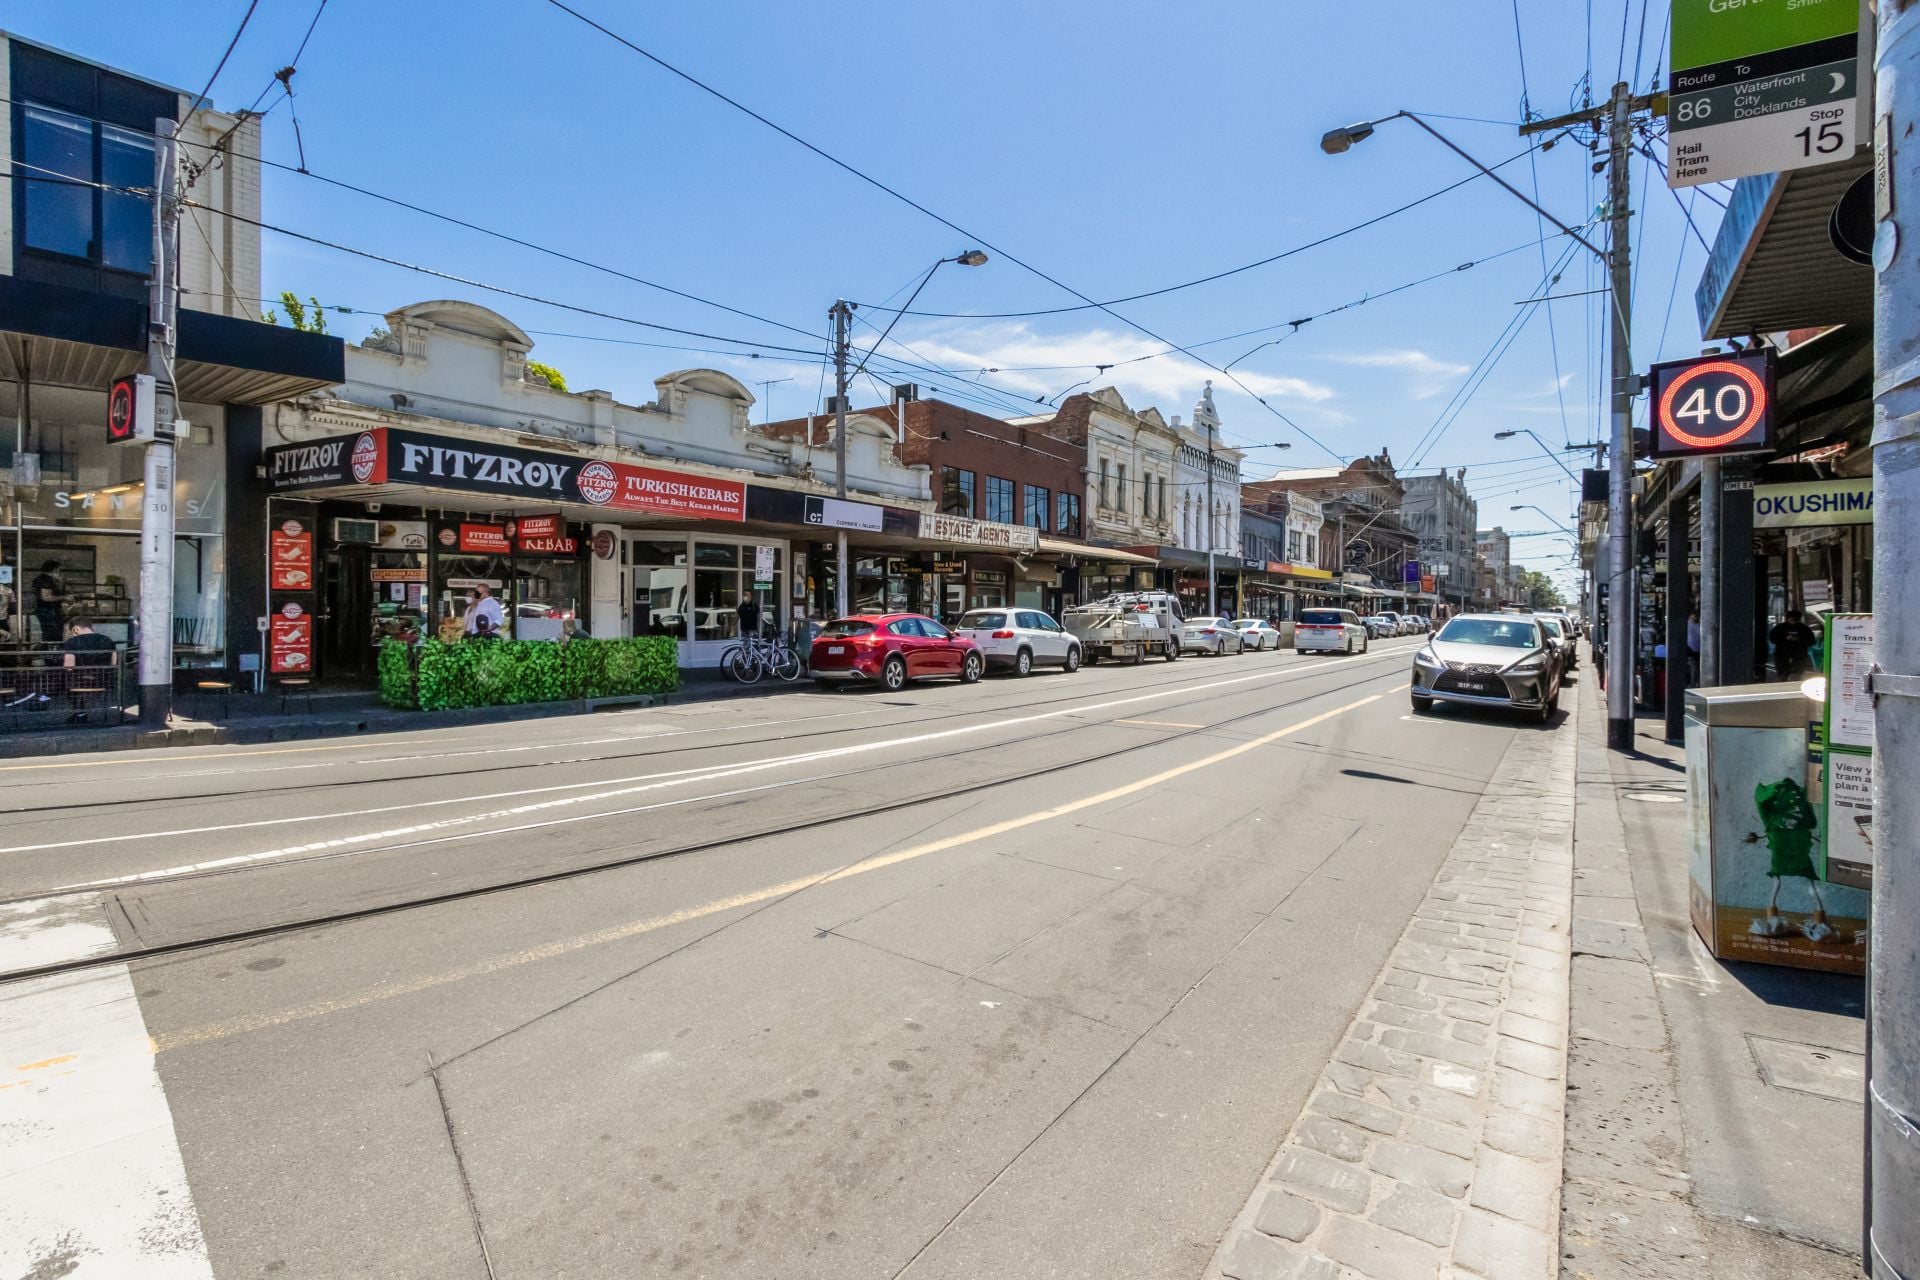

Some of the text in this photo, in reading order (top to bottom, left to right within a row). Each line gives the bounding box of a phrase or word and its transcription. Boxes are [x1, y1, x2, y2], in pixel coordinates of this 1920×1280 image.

[1678, 64, 1751, 87] Route To
[1735, 73, 1806, 95] Waterfront
[1735, 93, 1760, 108] City
[1735, 97, 1806, 119] Docklands
[1677, 98, 1712, 122] 86
[1810, 107, 1844, 122] Stop
[1795, 121, 1843, 157] 15
[1677, 143, 1702, 156] Hail
[1677, 154, 1709, 167] Tram
[1677, 166, 1707, 178] Here
[112, 397, 128, 422] 40
[1676, 384, 1746, 424] 40
[274, 442, 344, 475] FITZROY
[400, 442, 572, 491] FITZROY
[576, 475, 619, 490] FITZROY
[625, 476, 740, 504] TURKISH KEBABS
[152, 503, 168, 513] 30
[655, 496, 669, 505] THE
[670, 498, 688, 507] BEST
[688, 500, 712, 510] KEBAB
[1753, 490, 1873, 515] OKUSHIMA
[524, 519, 552, 528] FITZROY
[469, 531, 504, 540] FITZROY
[935, 520, 972, 539] ESTATE
[976, 524, 1011, 543] AGENTS
[525, 538, 573, 552] KEBAB
[1836, 762, 1862, 772] View
[1836, 773, 1861, 782] tram
[1835, 781, 1859, 790] plan
